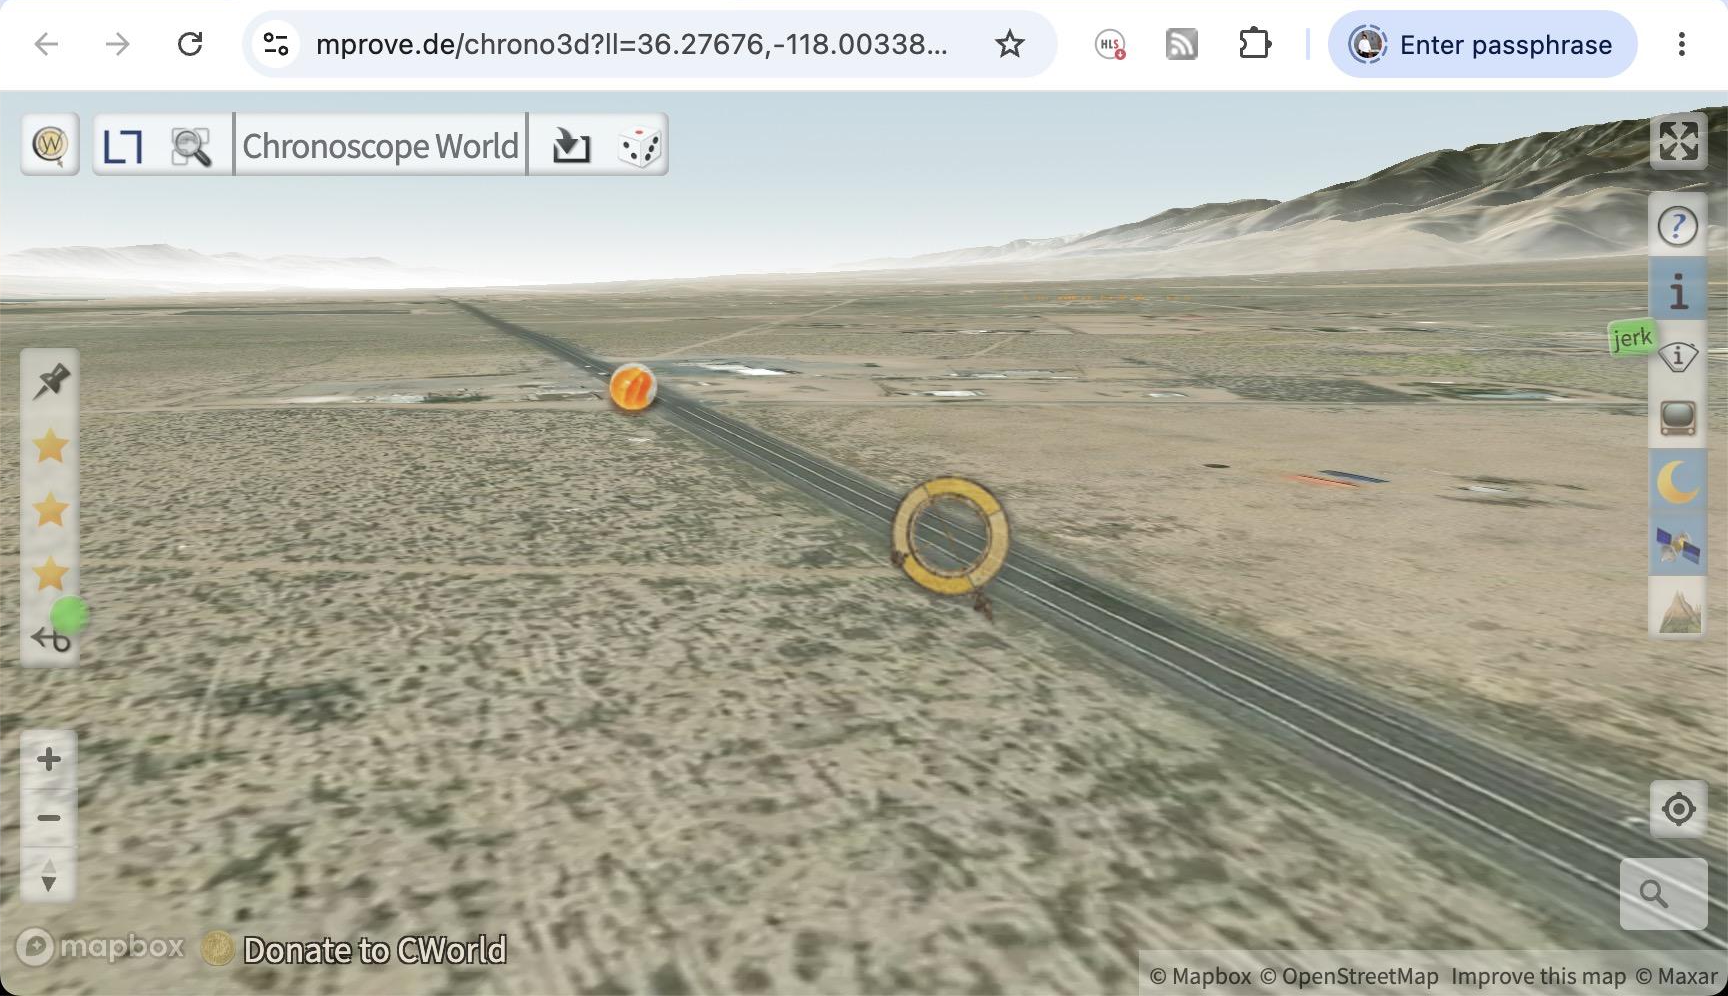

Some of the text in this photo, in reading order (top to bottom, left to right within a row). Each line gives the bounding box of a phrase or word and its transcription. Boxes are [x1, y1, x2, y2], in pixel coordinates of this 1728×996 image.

[317, 32, 947, 60] mprove.de/chrono3d?ll=36.27676,-118.00338...
[1101, 39, 1119, 49] HLS
[1401, 33, 1613, 60] Enter passphrase
[242, 130, 519, 162] Chronoscope World
[1614, 327, 1653, 353] jerk
[60, 932, 185, 964] mapbox
[243, 934, 507, 965] Donate to CWorld
[1173, 966, 1252, 990] Mapbox
[1282, 967, 1439, 990] OpenStreetMap
[1452, 966, 1627, 990] Improve this map
[1658, 967, 1719, 985] Maxar
